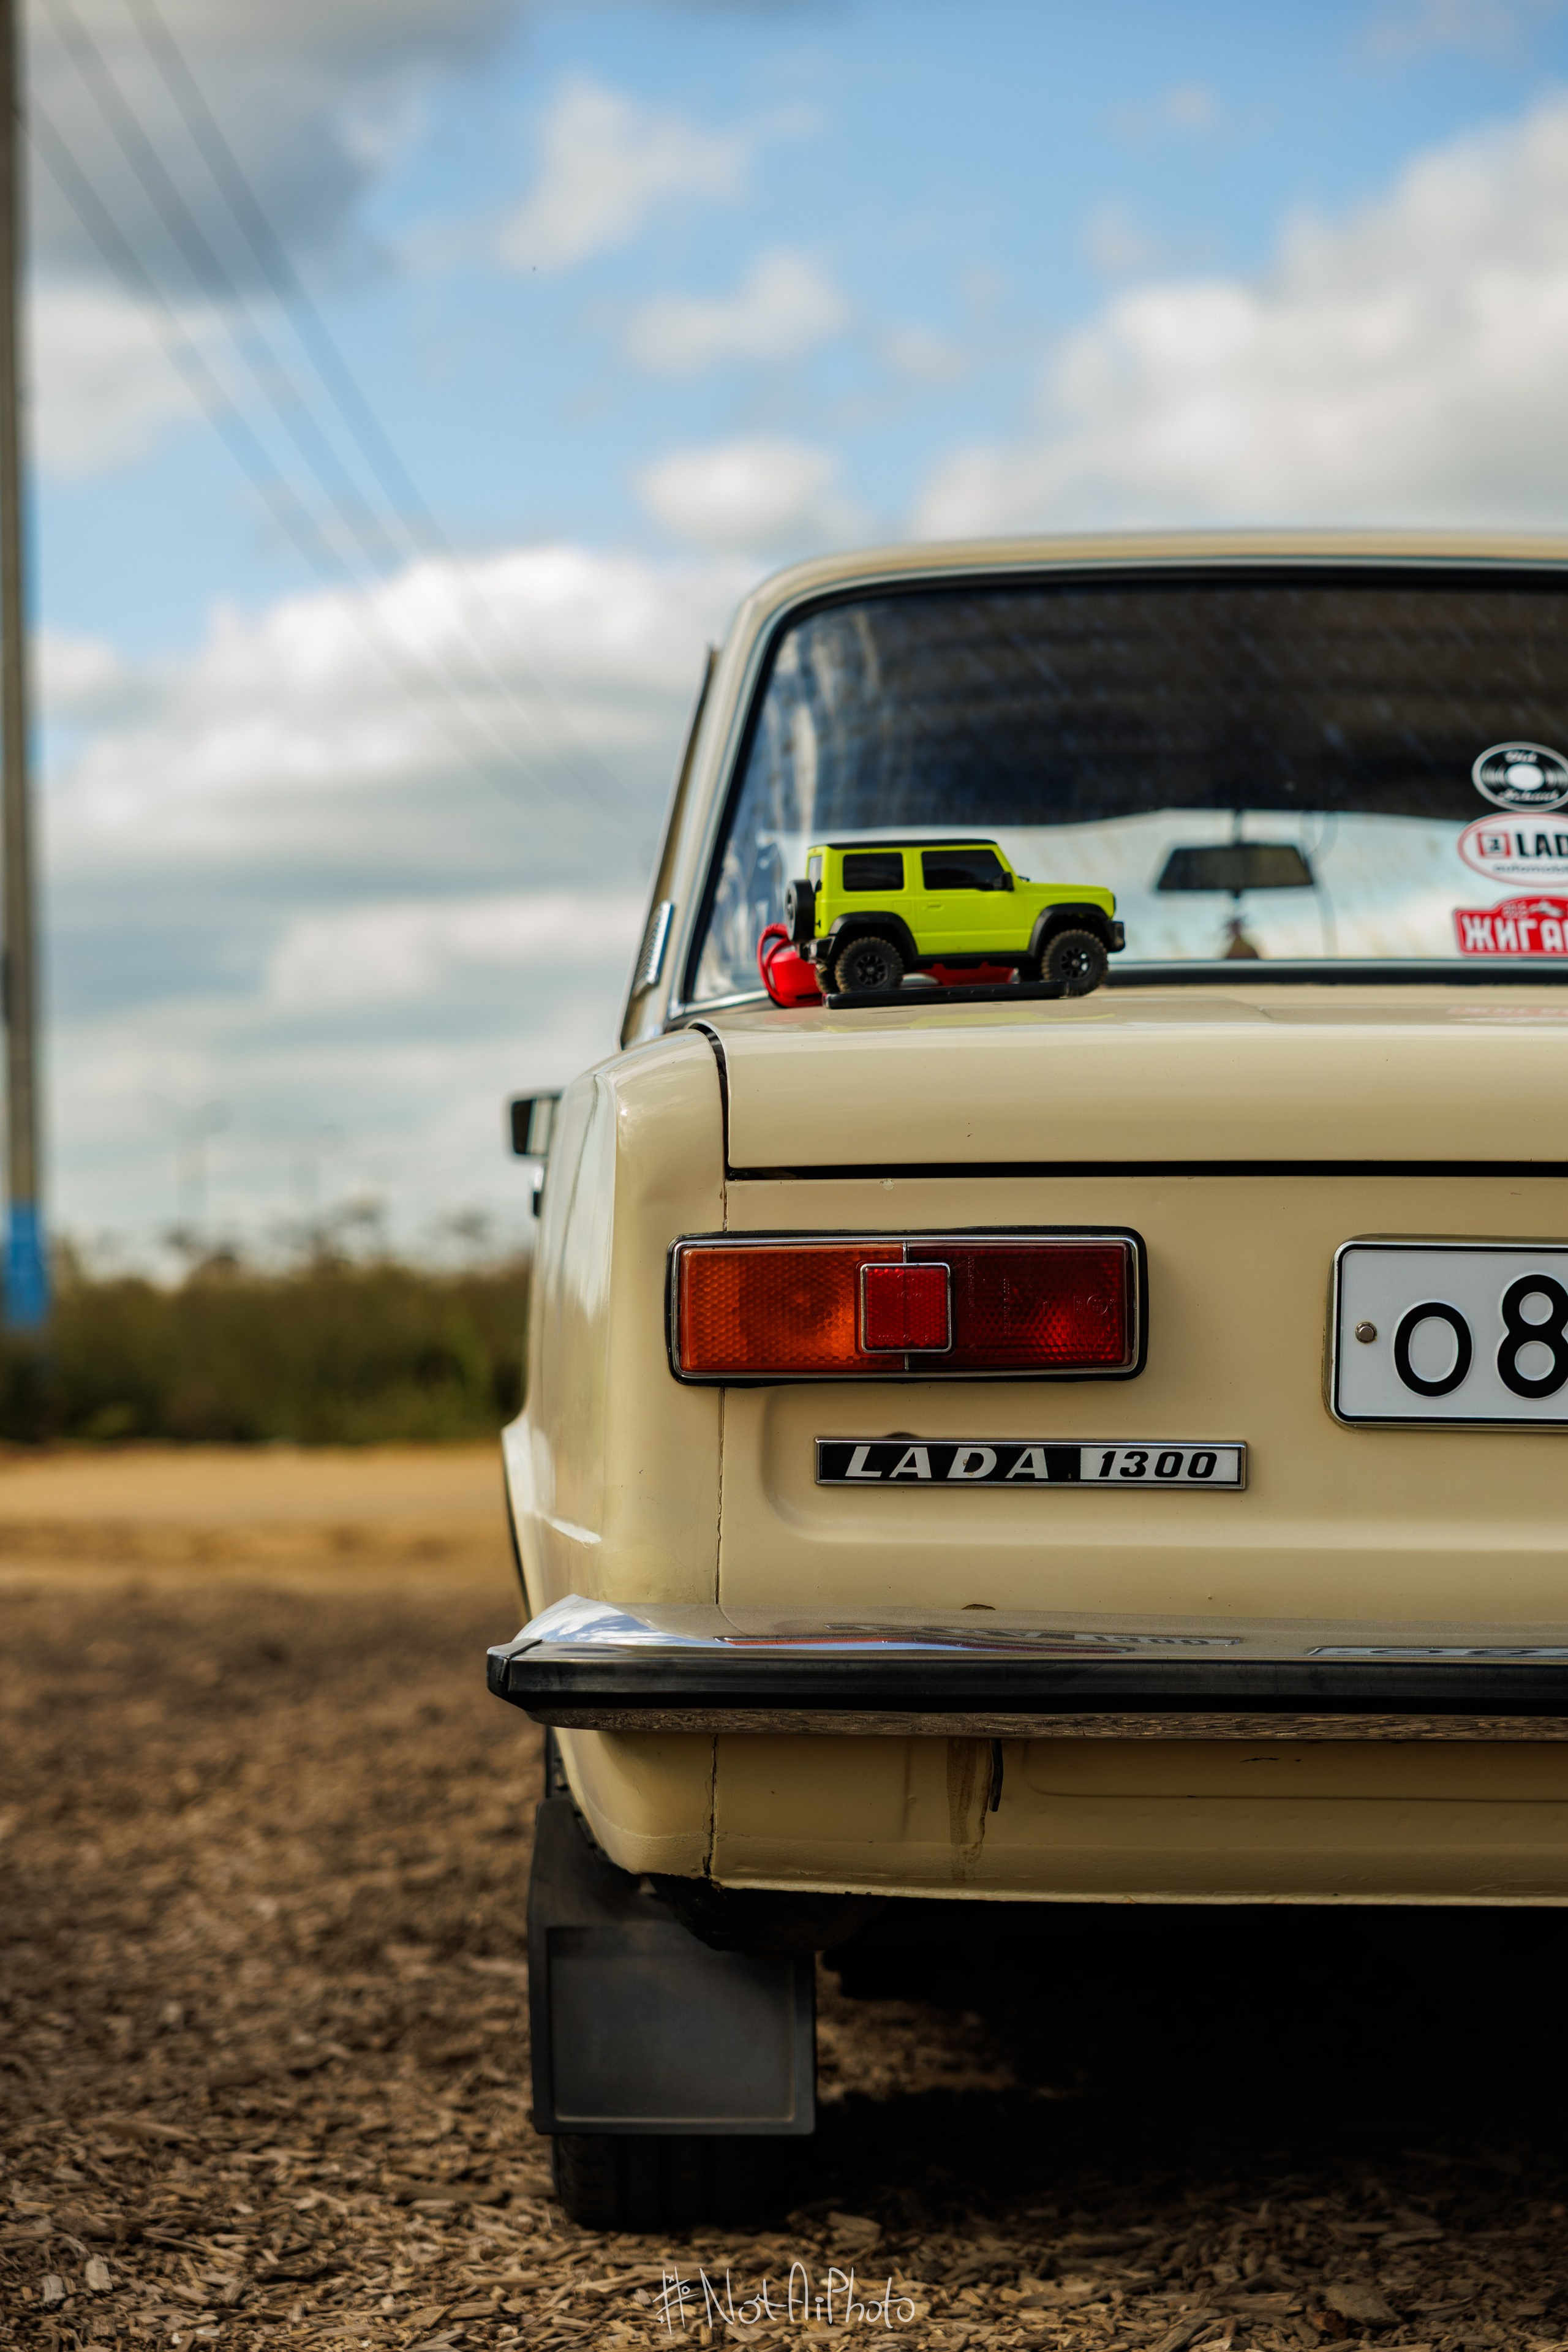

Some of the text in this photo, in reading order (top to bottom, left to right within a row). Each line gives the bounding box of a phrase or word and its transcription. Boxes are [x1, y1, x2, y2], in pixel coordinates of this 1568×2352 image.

[1461, 914, 1568, 951] ЖИГА
[845, 1446, 1218, 1479] LADA 1300
